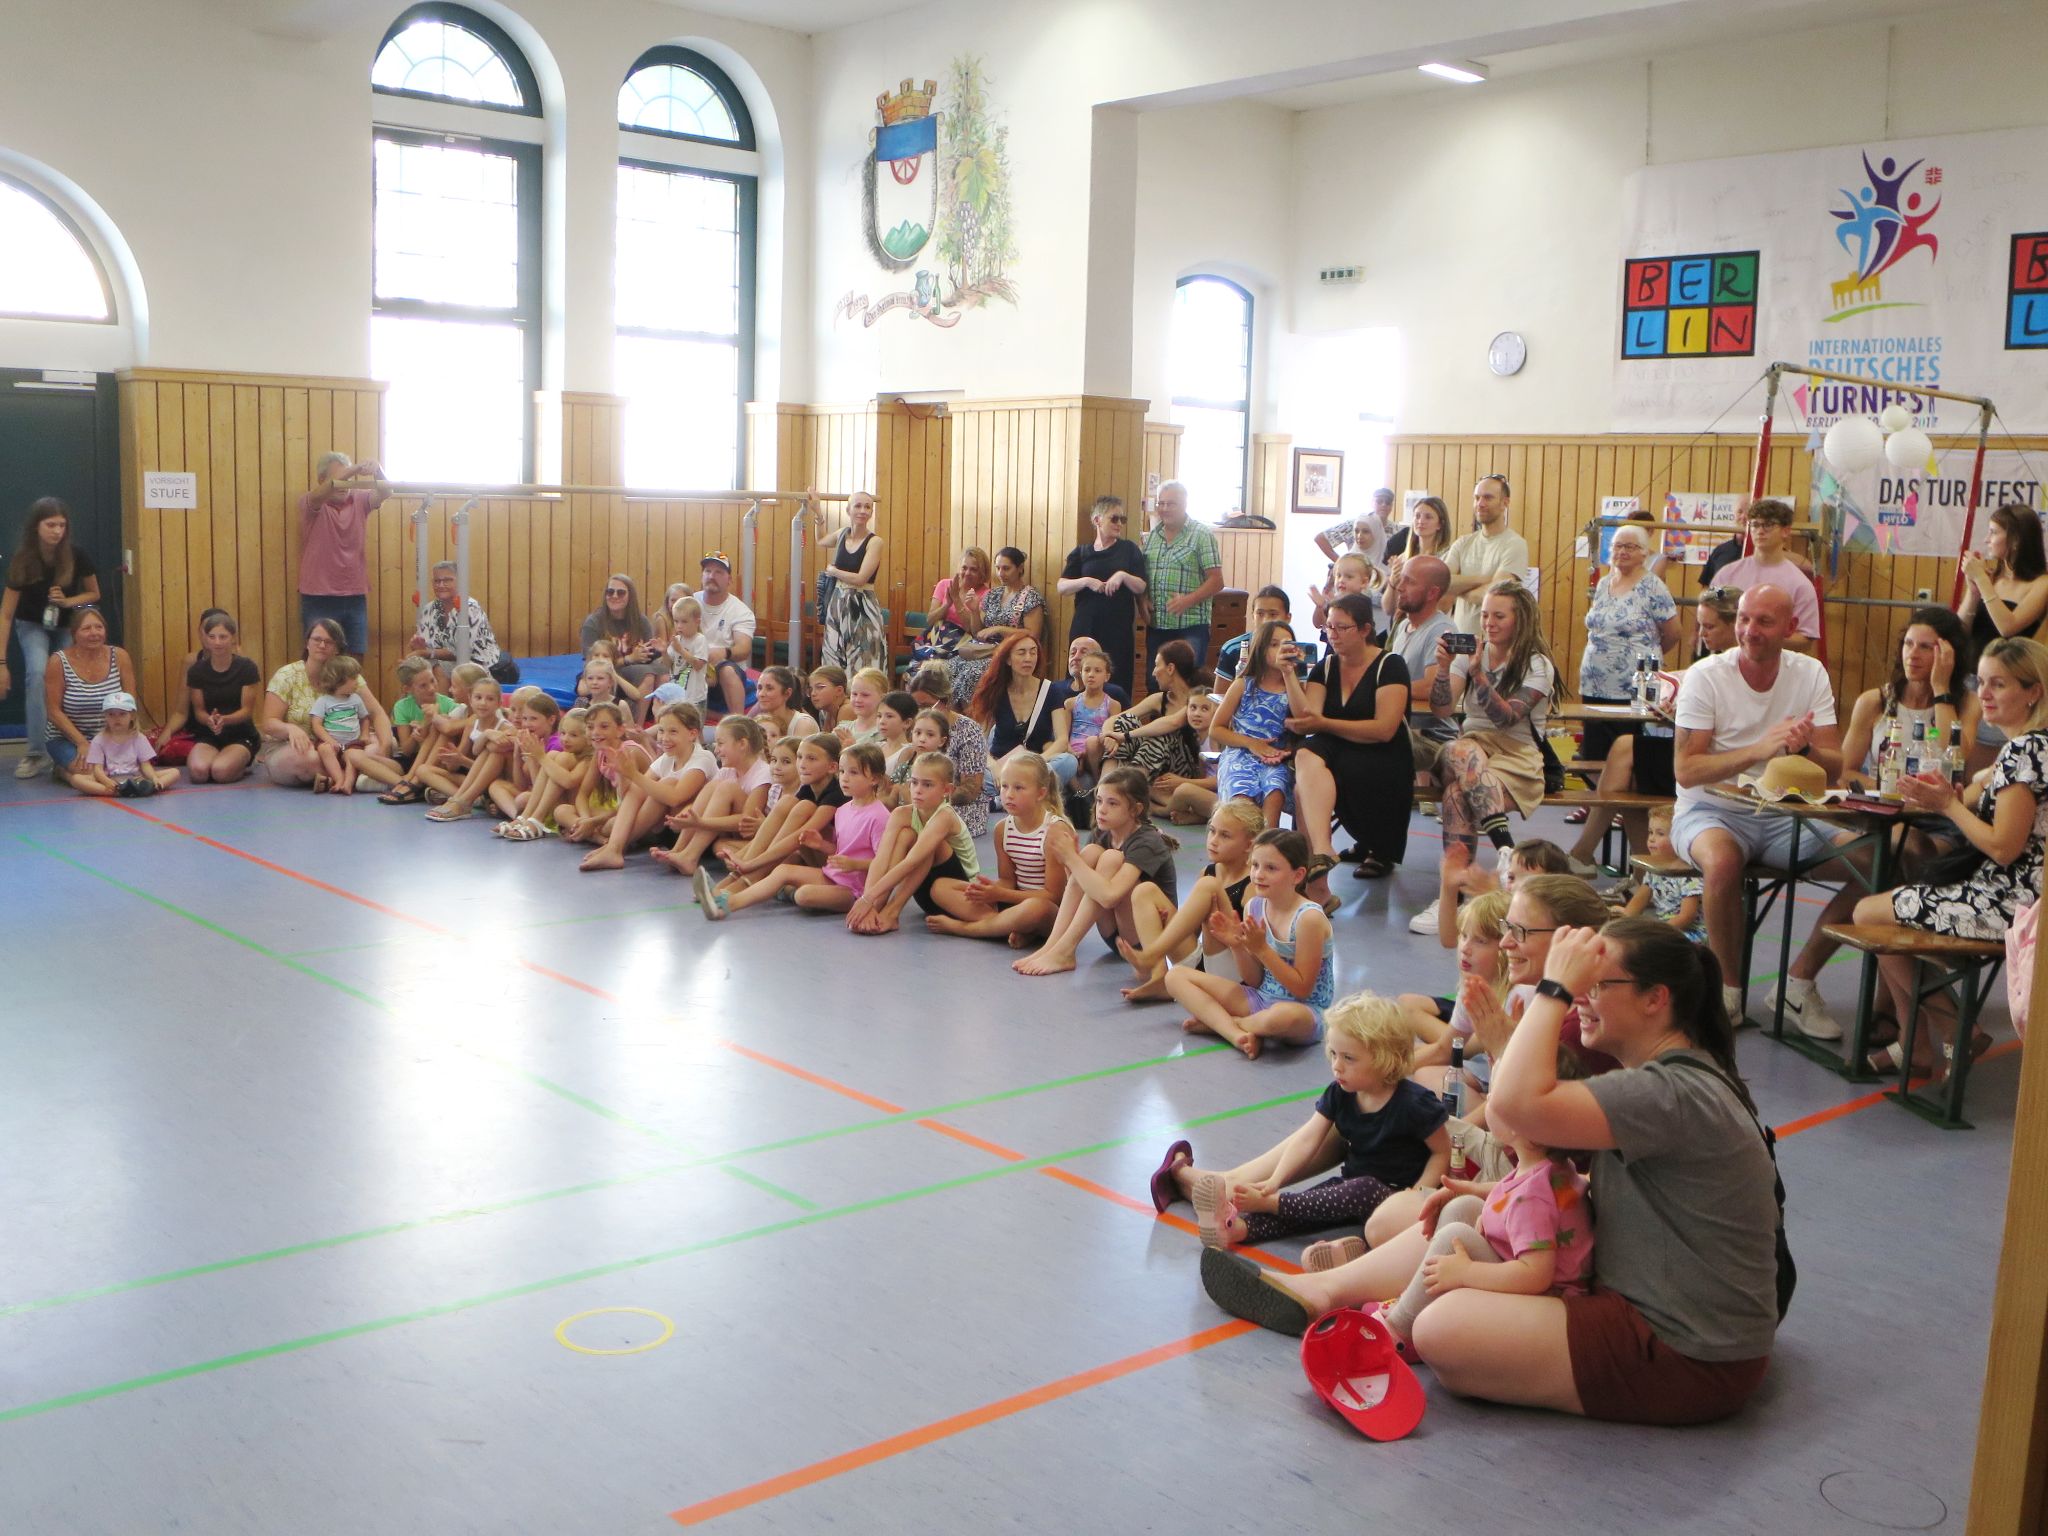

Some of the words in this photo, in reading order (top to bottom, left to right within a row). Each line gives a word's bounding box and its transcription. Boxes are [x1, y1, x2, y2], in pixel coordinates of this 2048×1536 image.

[1638, 262, 1751, 302] BER
[1635, 314, 1749, 348] LIN
[1809, 336, 1942, 355] INTERNATIONALES
[1808, 355, 1940, 383] DEUTSCHES
[149, 476, 190, 486] VORSICHT
[150, 487, 191, 499] STUFE
[1879, 478, 1920, 504] DAS
